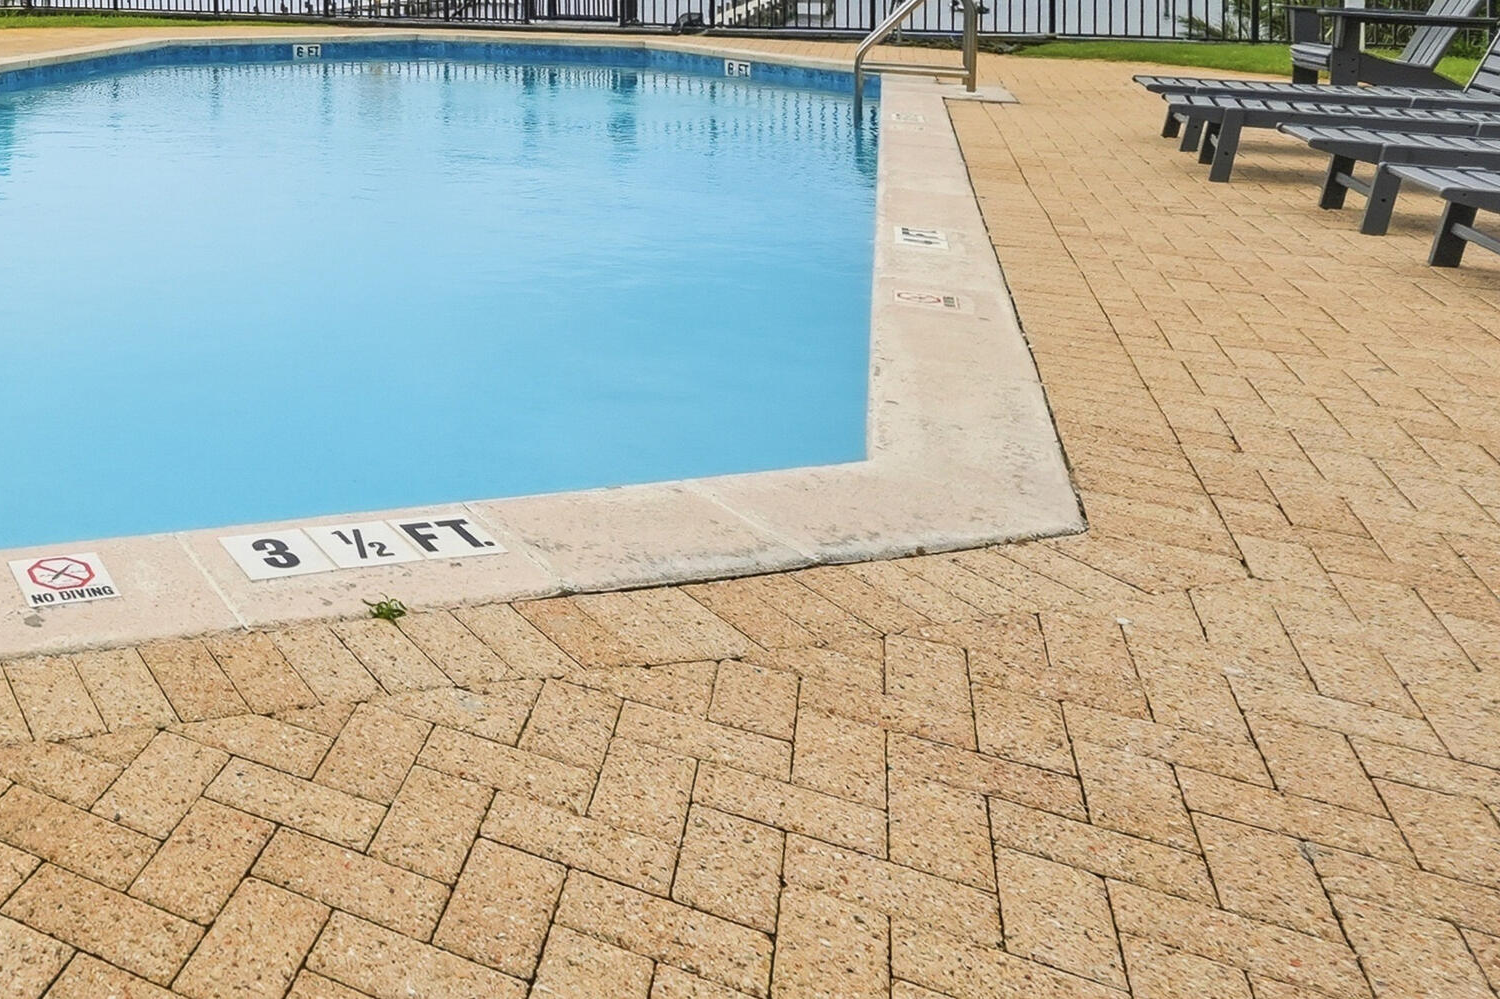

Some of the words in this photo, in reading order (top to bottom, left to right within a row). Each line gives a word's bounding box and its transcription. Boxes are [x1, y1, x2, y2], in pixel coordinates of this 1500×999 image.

[251, 538, 301, 569] 3
[399, 518, 496, 552] FT.
[31, 592, 55, 605] NO
[59, 585, 115, 601] DIVING
